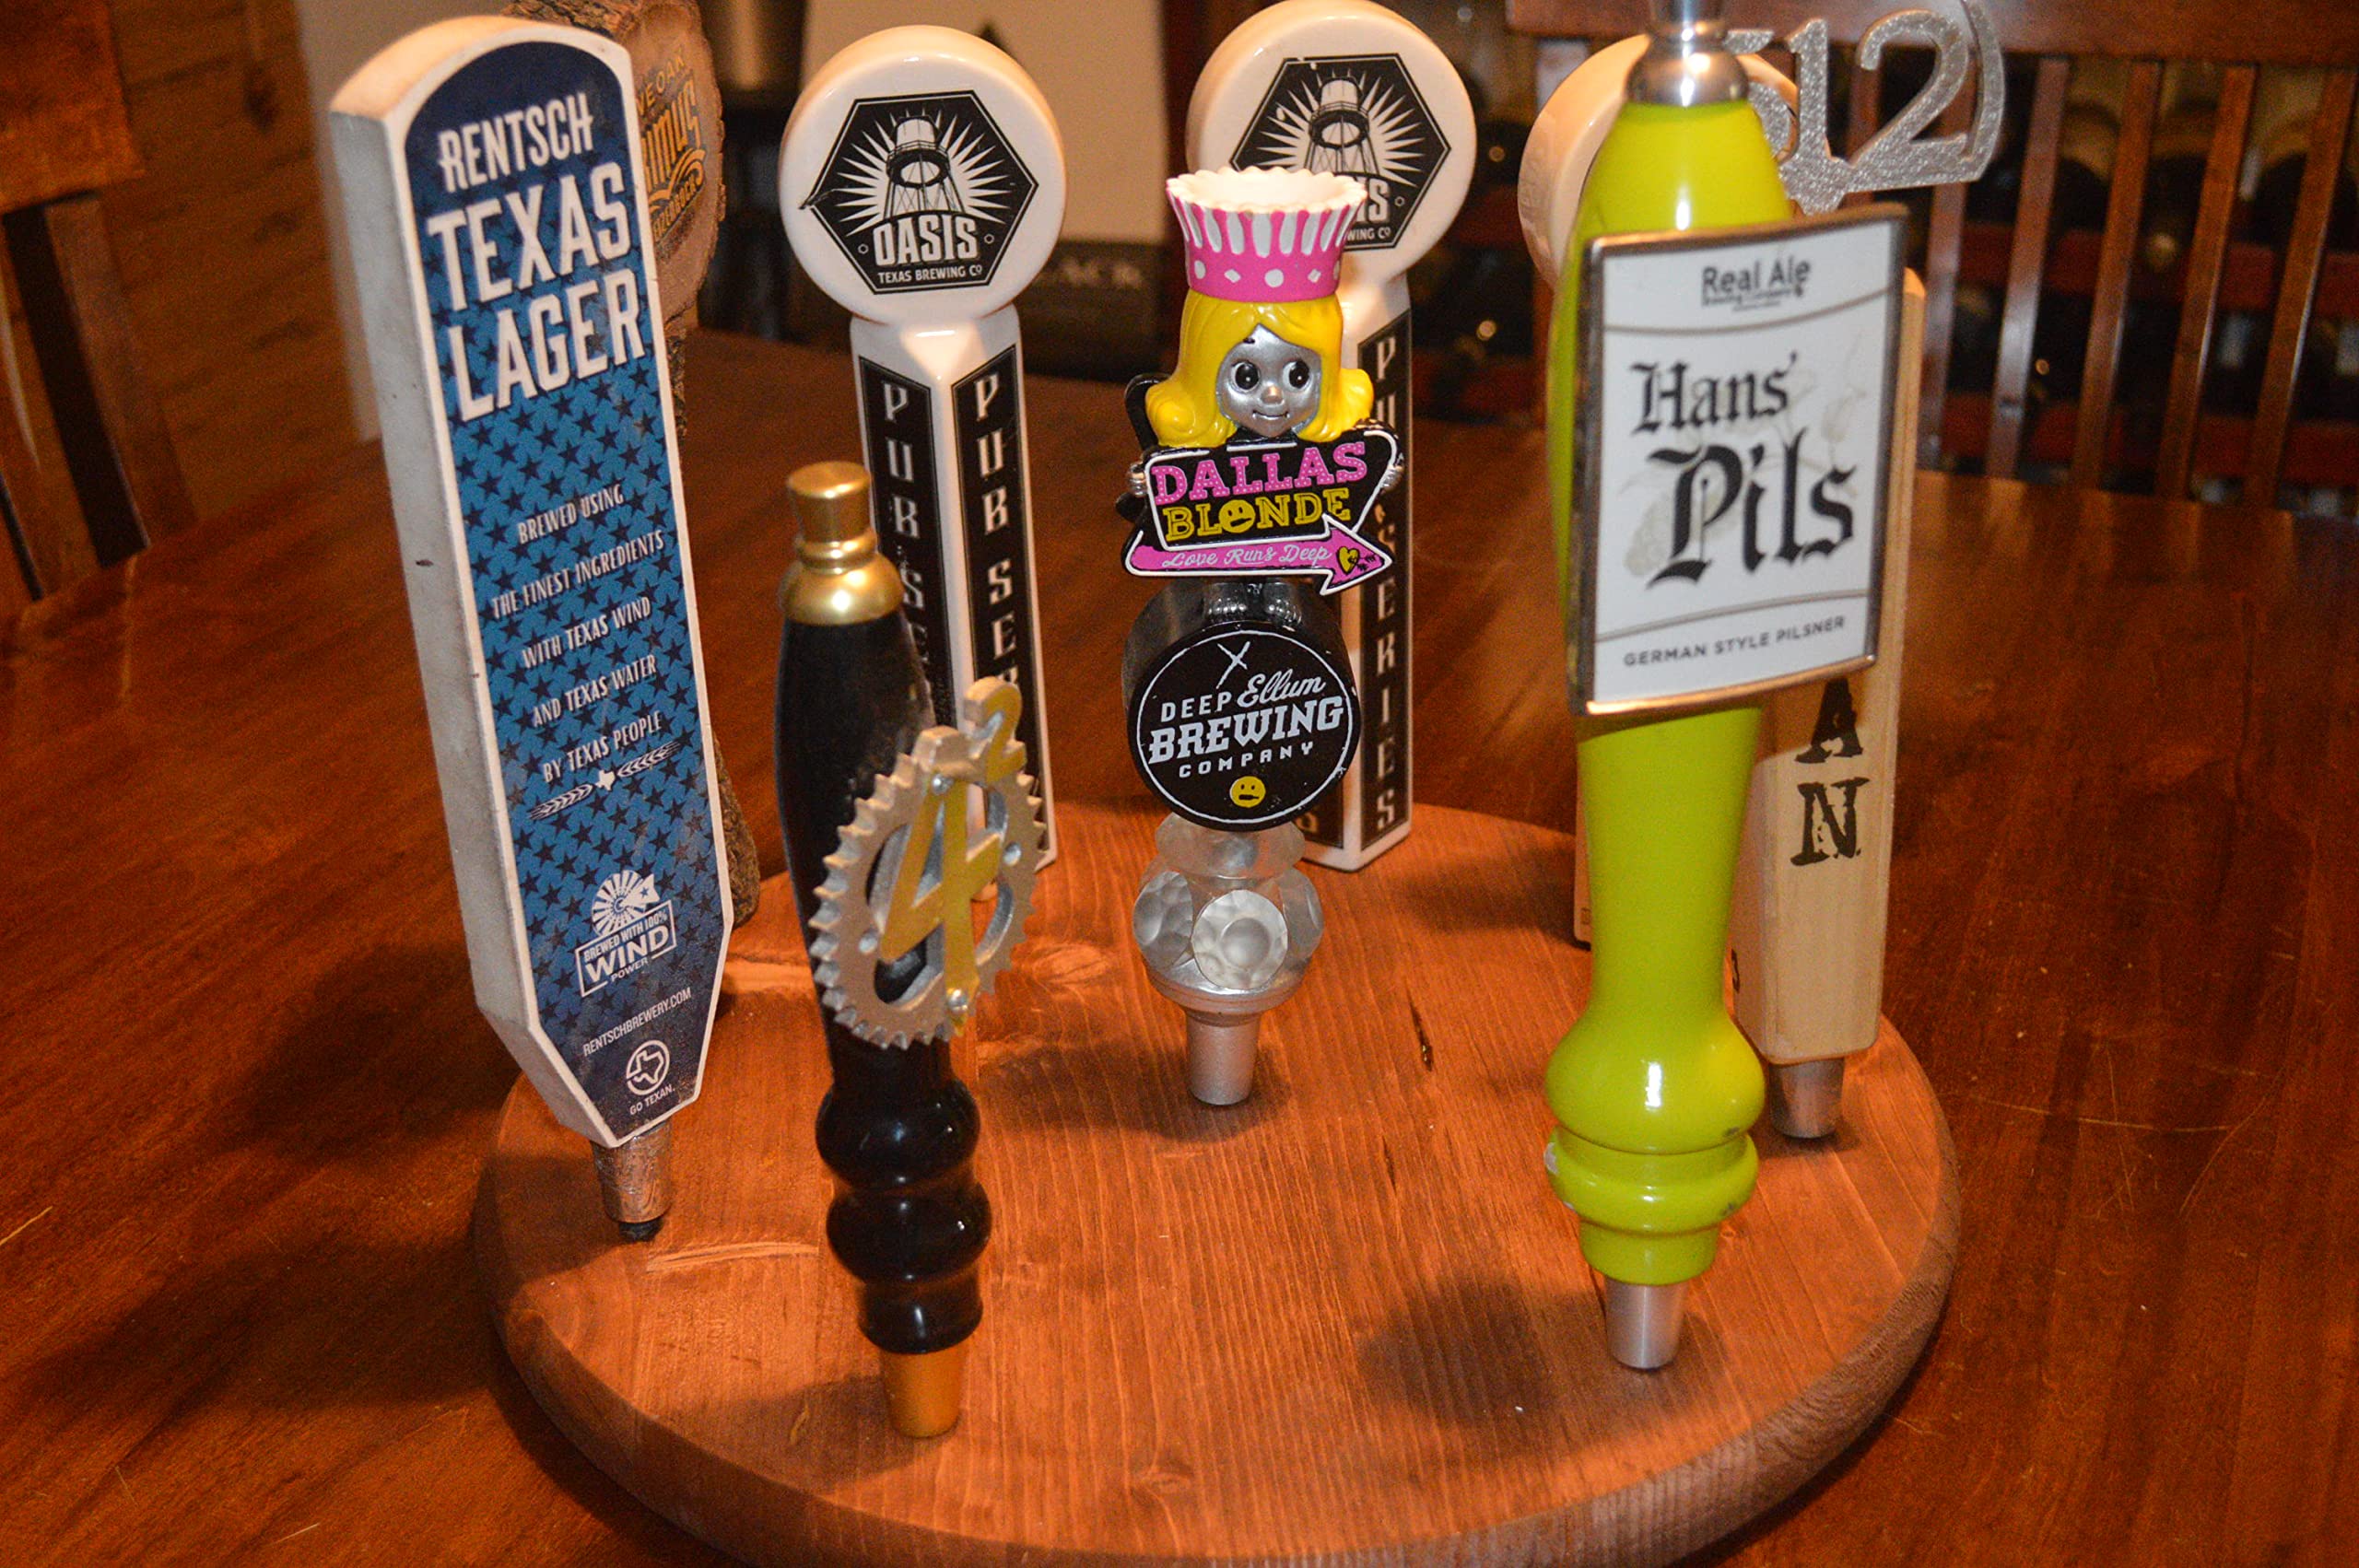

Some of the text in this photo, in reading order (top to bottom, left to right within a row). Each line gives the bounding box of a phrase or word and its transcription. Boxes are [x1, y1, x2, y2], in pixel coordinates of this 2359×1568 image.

[439, 93, 593, 193] RENTSCH
[427, 162, 631, 311] TEXAS
[873, 215, 979, 266] OASIS
[877, 271, 912, 284] TEXAS
[916, 265, 966, 281] BREWING
[1702, 255, 1812, 295] Real Ale
[449, 269, 645, 422] LAGER
[1151, 441, 1368, 506] DALLAS
[518, 484, 625, 544] BREWED USING
[1646, 427, 1857, 591] Pils
[492, 530, 664, 619] THE FINEST INGREDIENTS
[1162, 551, 1218, 568] Love
[1279, 544, 1332, 566] Deep
[522, 597, 651, 669] WITH TEXAS WIND
[1624, 615, 1846, 667] GERMAN STYLE PILSNER
[533, 654, 657, 727] AND TEXAS WATER
[1161, 668, 1327, 723] DEEP Ellum
[543, 710, 662, 783] BY TEXAS PEOPLE
[1148, 696, 1344, 765] BREWING
[1179, 741, 1314, 779] COMPANY
[583, 909, 668, 963] BREWED WITH 100%
[585, 925, 670, 983] WIND
[610, 956, 650, 983] POWER
[582, 987, 692, 1057] RENTSCHBREWERY.COM
[629, 1101, 644, 1116] GO
